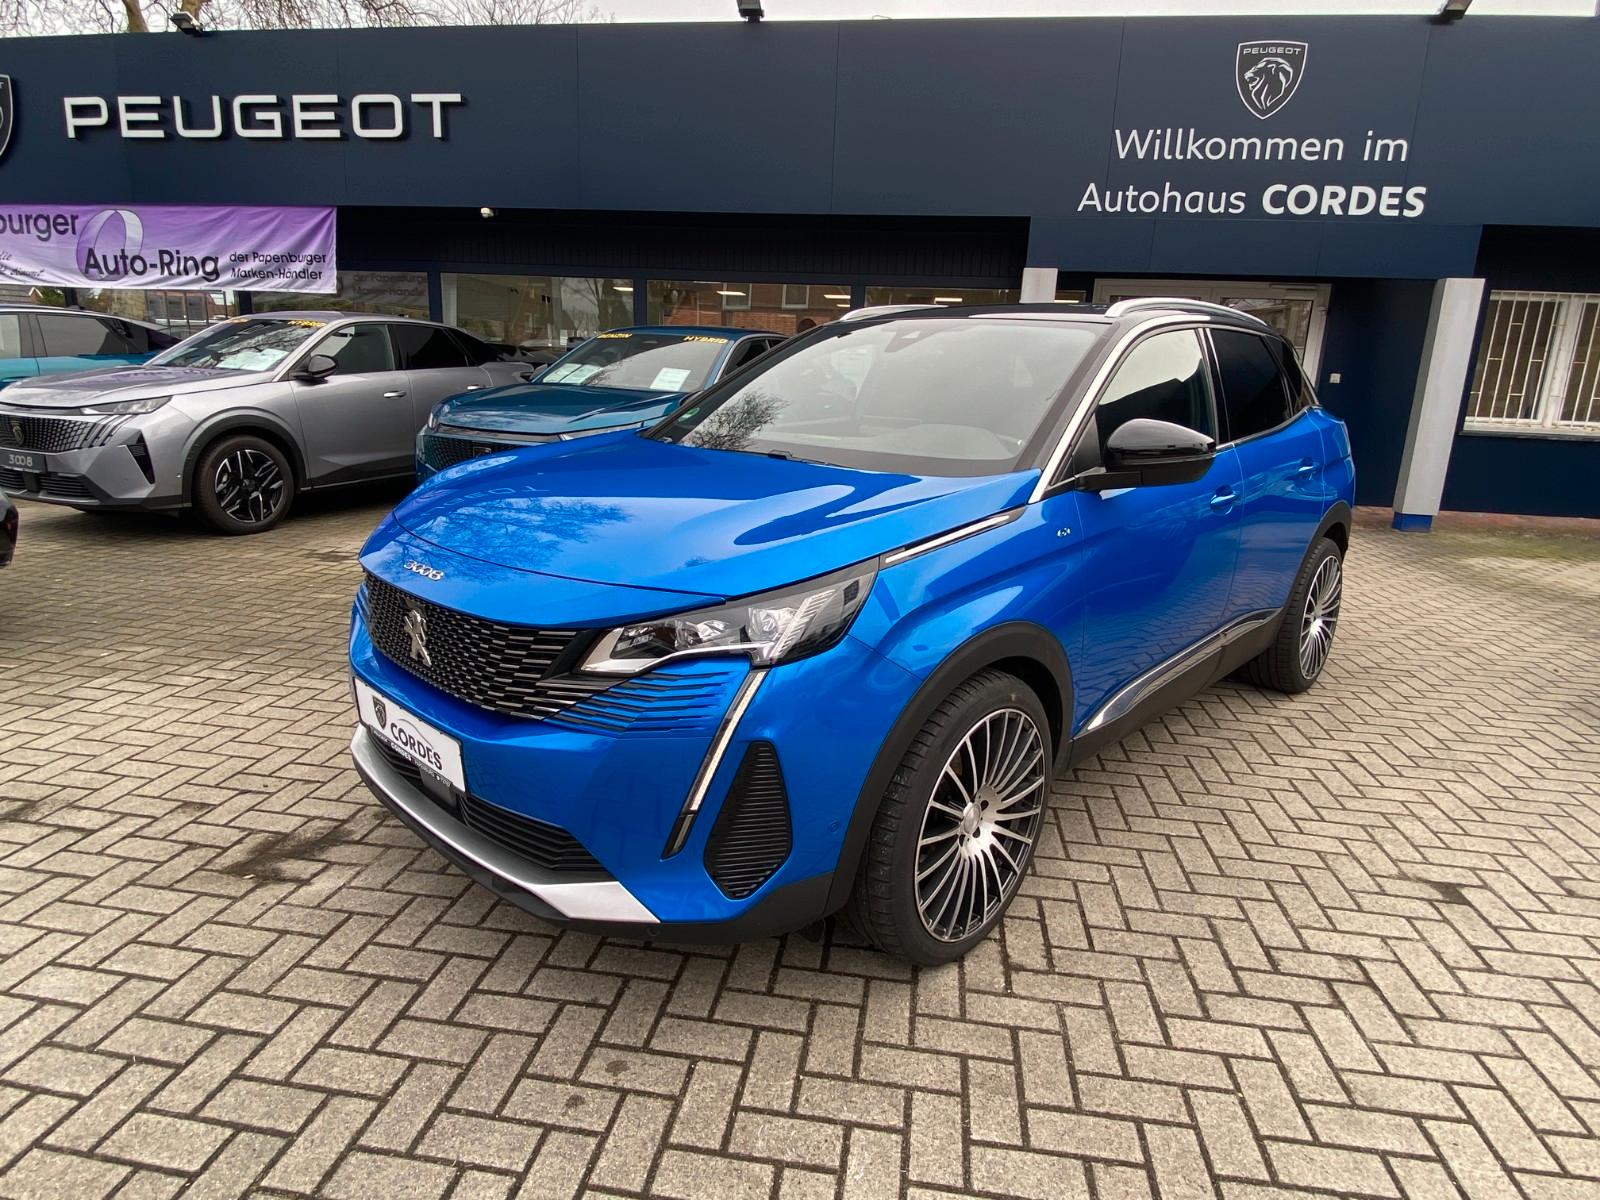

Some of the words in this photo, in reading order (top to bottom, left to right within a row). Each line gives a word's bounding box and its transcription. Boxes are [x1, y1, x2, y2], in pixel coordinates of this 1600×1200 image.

[1243, 46, 1302, 55] PEUGEOT
[64, 93, 462, 140] PEUGEOT
[1115, 128, 1344, 161] Willkommen
[1363, 131, 1409, 162] im
[1077, 182, 1247, 214] Autohaus
[1262, 184, 1427, 218] CORDES
[85, 248, 220, 281] Auto-Ring
[229, 252, 249, 263] der
[252, 252, 327, 266] Papenburger
[231, 268, 323, 280] Marken-Händler
[683, 335, 729, 344] HYBRID
[9, 454, 33, 466] 3008
[403, 560, 444, 581] 3008
[390, 722, 443, 771] CORDES
